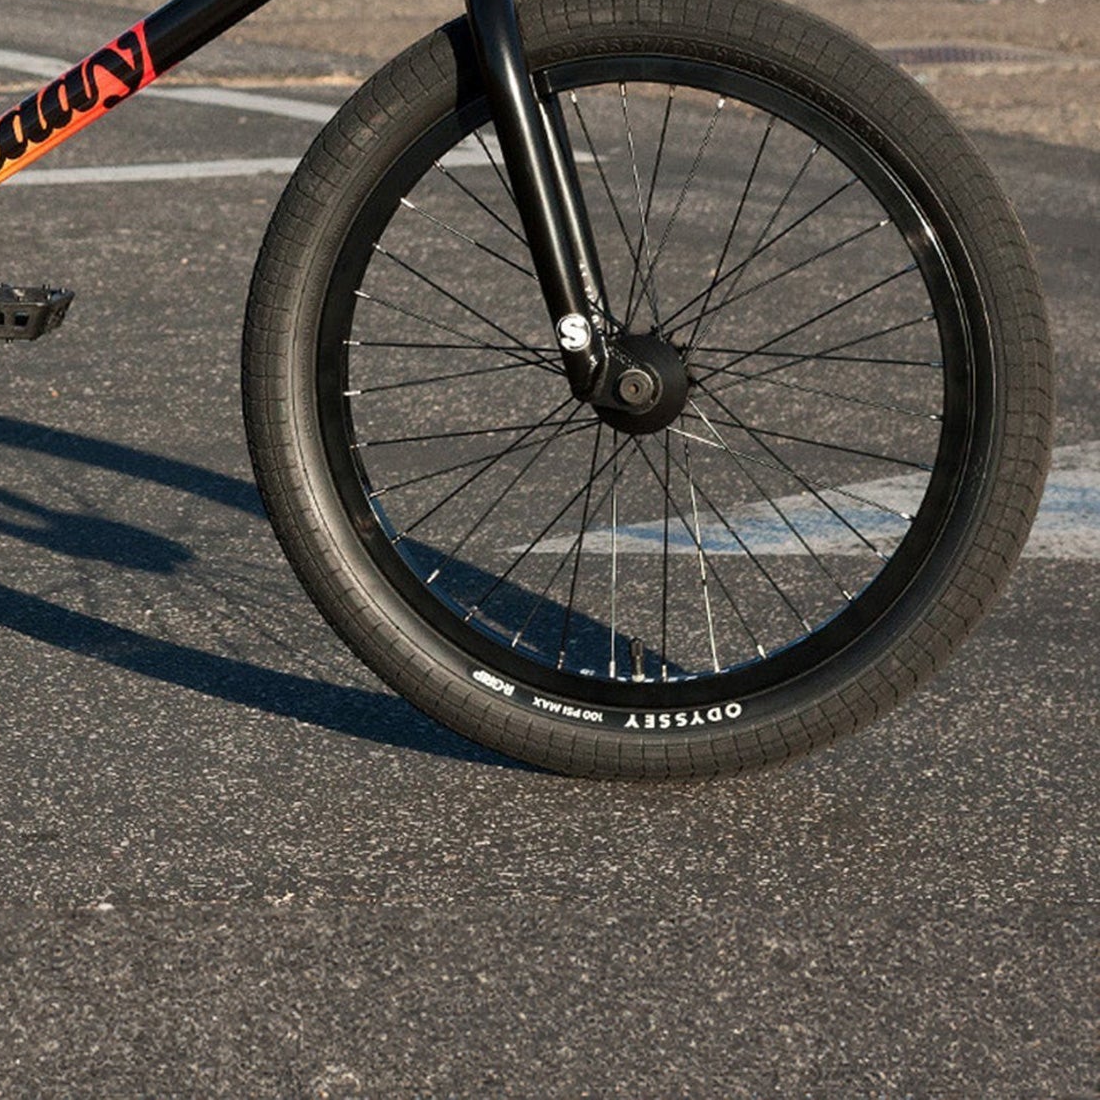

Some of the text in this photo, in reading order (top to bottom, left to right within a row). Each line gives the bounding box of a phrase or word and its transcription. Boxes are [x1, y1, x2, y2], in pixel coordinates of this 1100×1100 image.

[558, 314, 589, 351] S
[532, 696, 563, 714] MAX
[561, 704, 582, 719] PSI
[582, 710, 603, 722] 100
[624, 702, 742, 729] ODYSSEY
